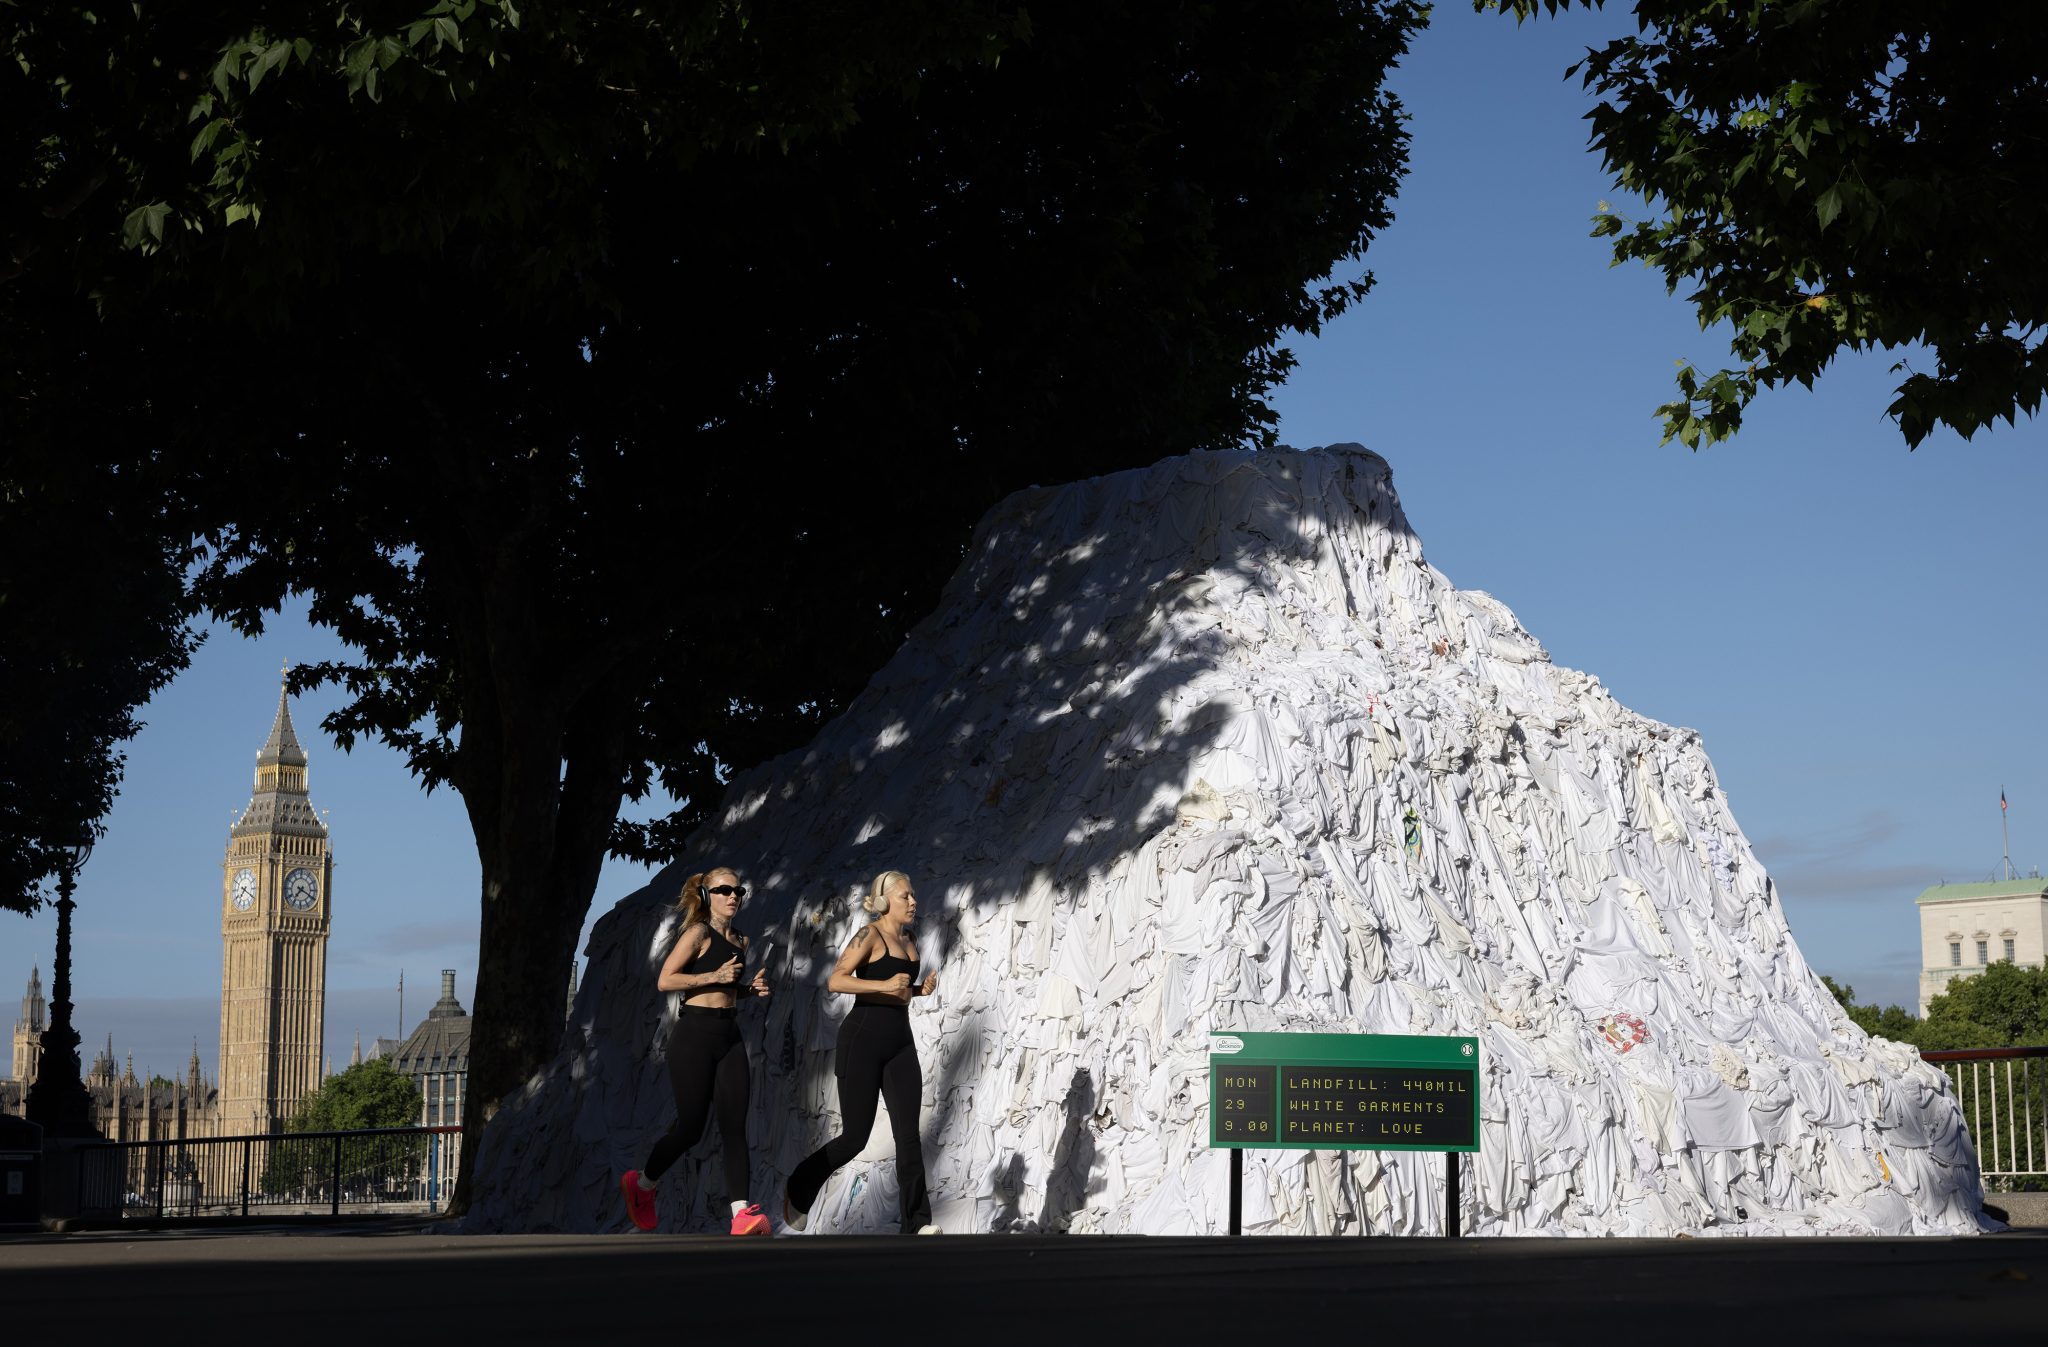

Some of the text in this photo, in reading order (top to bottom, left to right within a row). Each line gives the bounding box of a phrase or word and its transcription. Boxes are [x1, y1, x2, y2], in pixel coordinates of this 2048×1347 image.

[1225, 1077, 1257, 1088] MON
[1290, 1078, 1466, 1092] LANDFILL: 440MIL
[1225, 1100, 1246, 1110] 29
[1290, 1101, 1445, 1113] WHITE GARMENTS
[1225, 1121, 1268, 1132] 9.00
[1290, 1121, 1423, 1134] PLANET: LOVE
